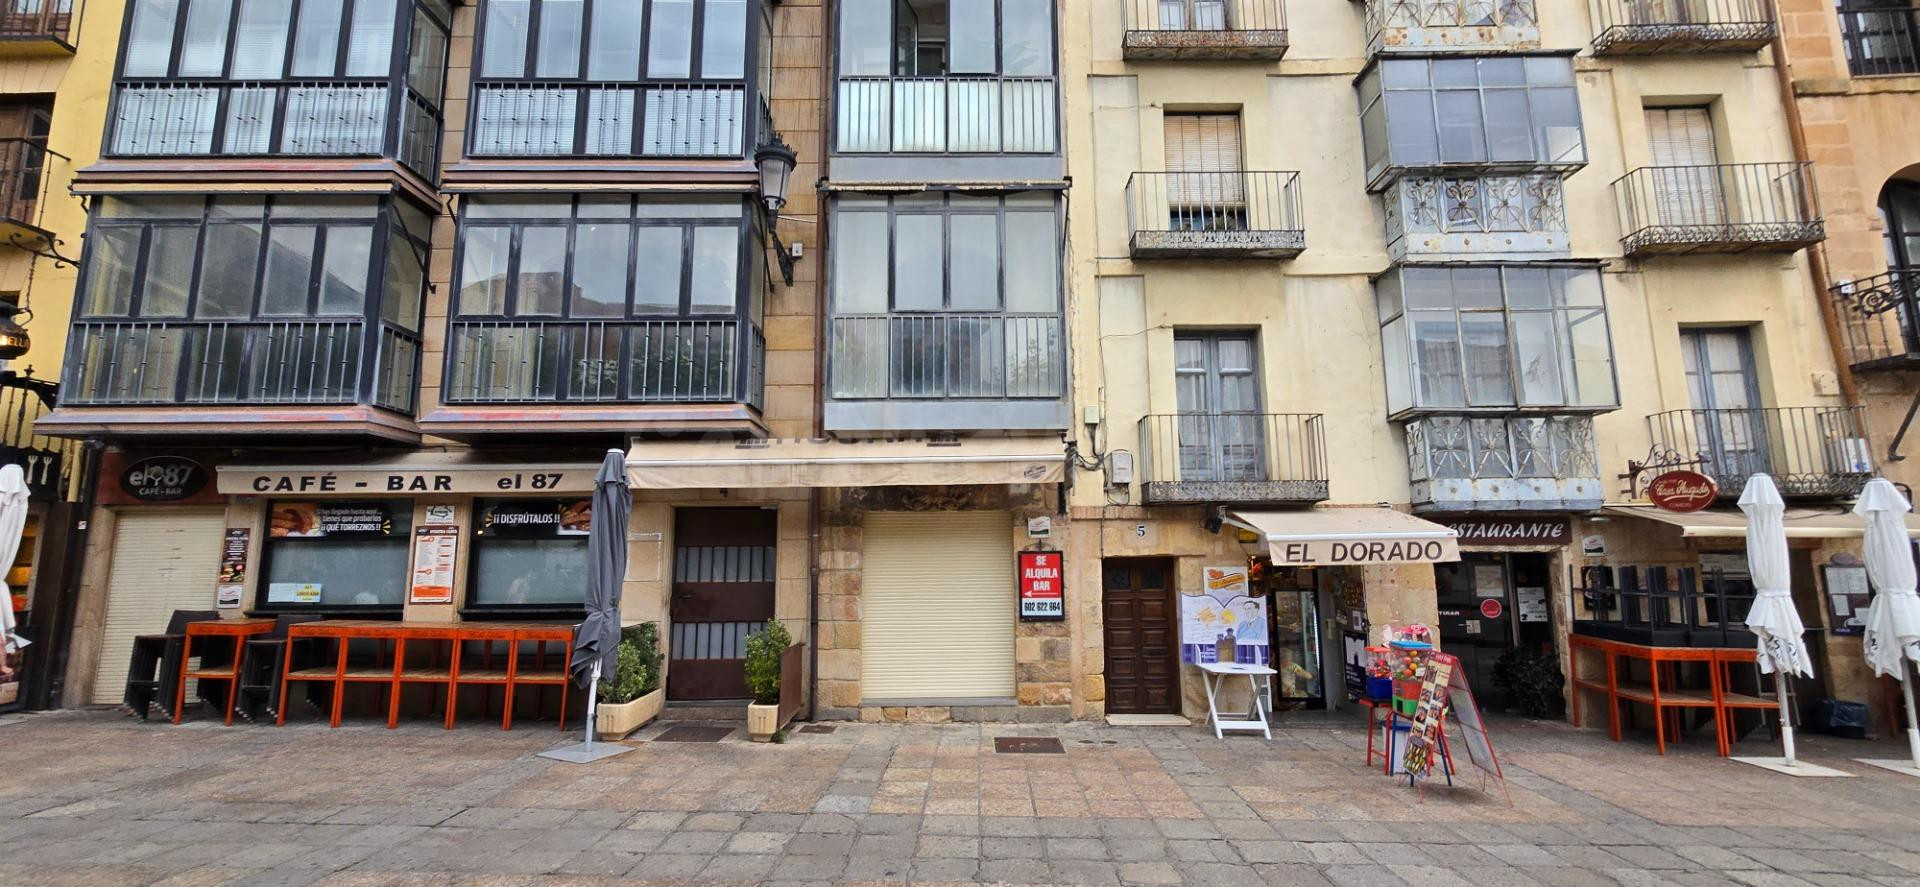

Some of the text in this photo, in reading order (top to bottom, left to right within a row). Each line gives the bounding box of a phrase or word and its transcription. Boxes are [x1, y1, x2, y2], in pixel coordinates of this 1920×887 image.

[163, 465, 194, 487] 87
[252, 472, 337, 492] CAFÉ
[387, 475, 452, 491] BAR
[497, 474, 522, 490] el
[531, 473, 563, 489] 87
[165, 487, 182, 495] BAR
[501, 512, 553, 524] DISFRÚTALOS
[326, 522, 339, 532] QUÉ
[1137, 525, 1146, 537] 5
[1286, 541, 1443, 562] EL DORADO
[1036, 555, 1047, 566] SE
[1024, 568, 1058, 579] ALQUILA
[1033, 581, 1050, 591] BAR
[1024, 602, 1036, 611] 602
